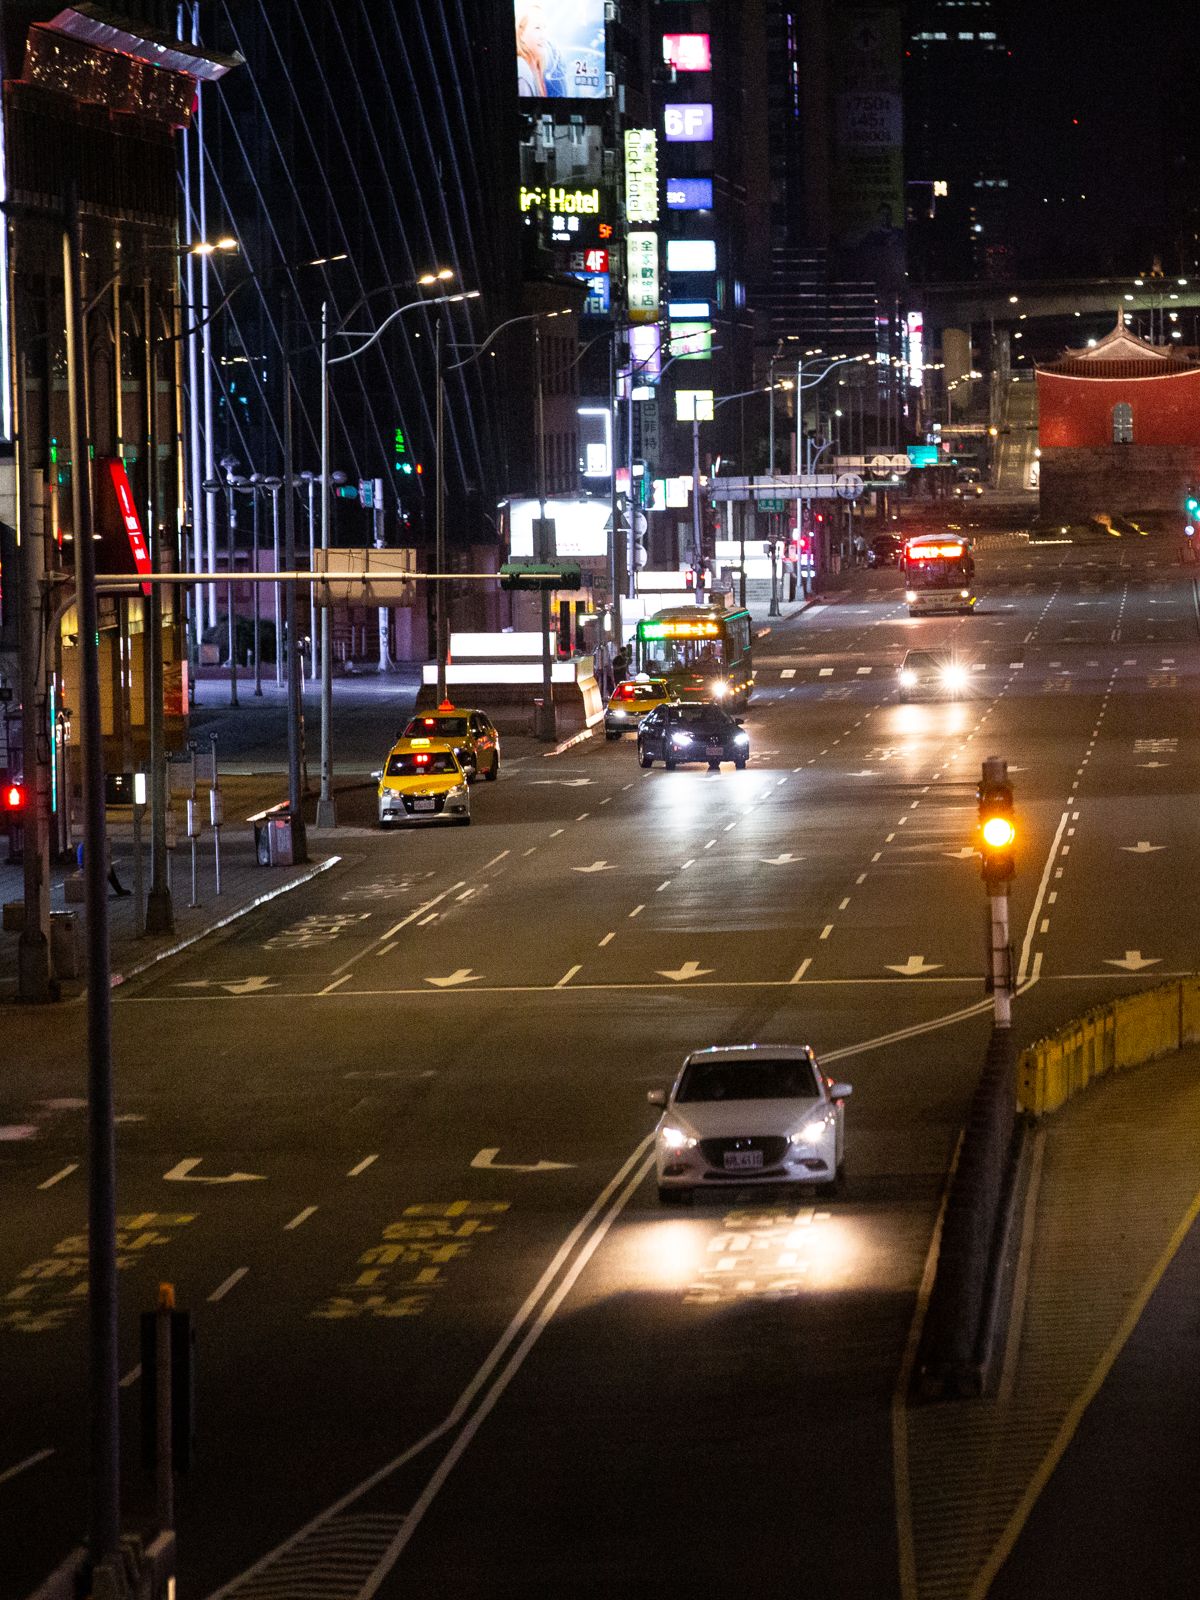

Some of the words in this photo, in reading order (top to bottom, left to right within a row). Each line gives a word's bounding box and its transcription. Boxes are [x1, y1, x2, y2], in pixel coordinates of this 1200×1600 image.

[664, 109, 704, 136] 6F
[627, 131, 642, 166] Click
[549, 187, 599, 213] Hotel
[628, 171, 643, 212] Hotel
[598, 223, 613, 239] 5F
[586, 250, 606, 271] 4F
